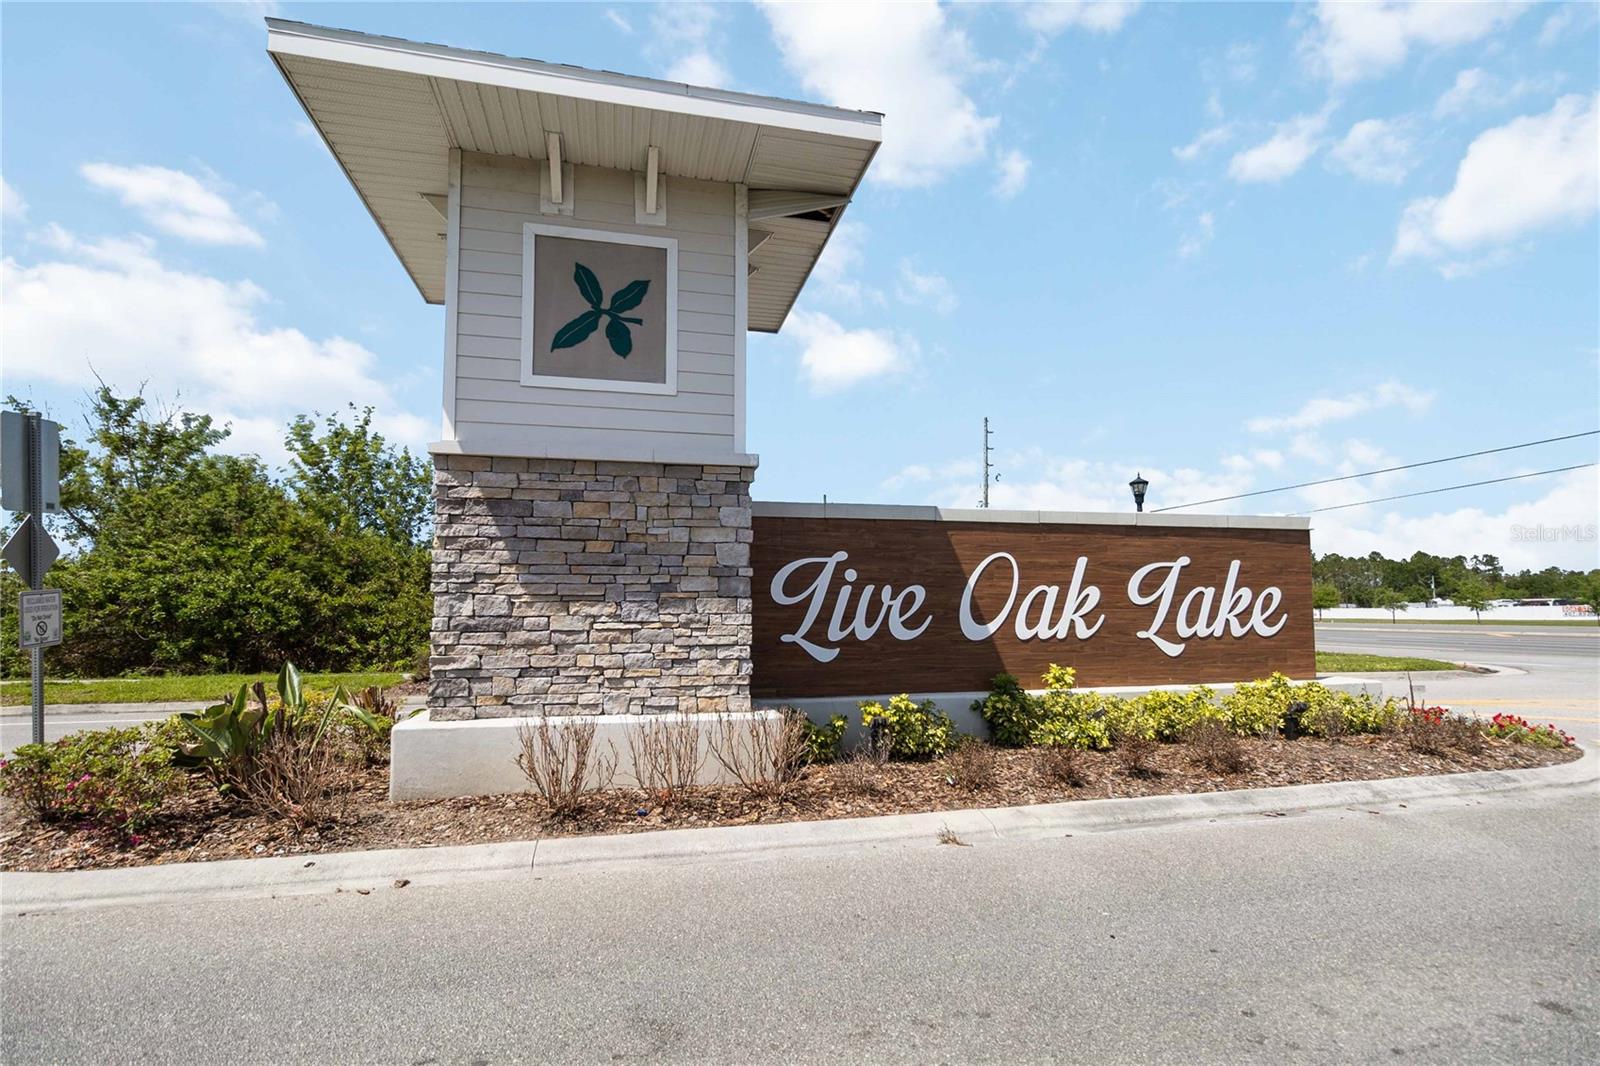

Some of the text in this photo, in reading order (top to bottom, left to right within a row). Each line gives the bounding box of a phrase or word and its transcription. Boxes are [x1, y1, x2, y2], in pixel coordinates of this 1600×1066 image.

[769, 550, 1288, 663] Live Oak Lake
